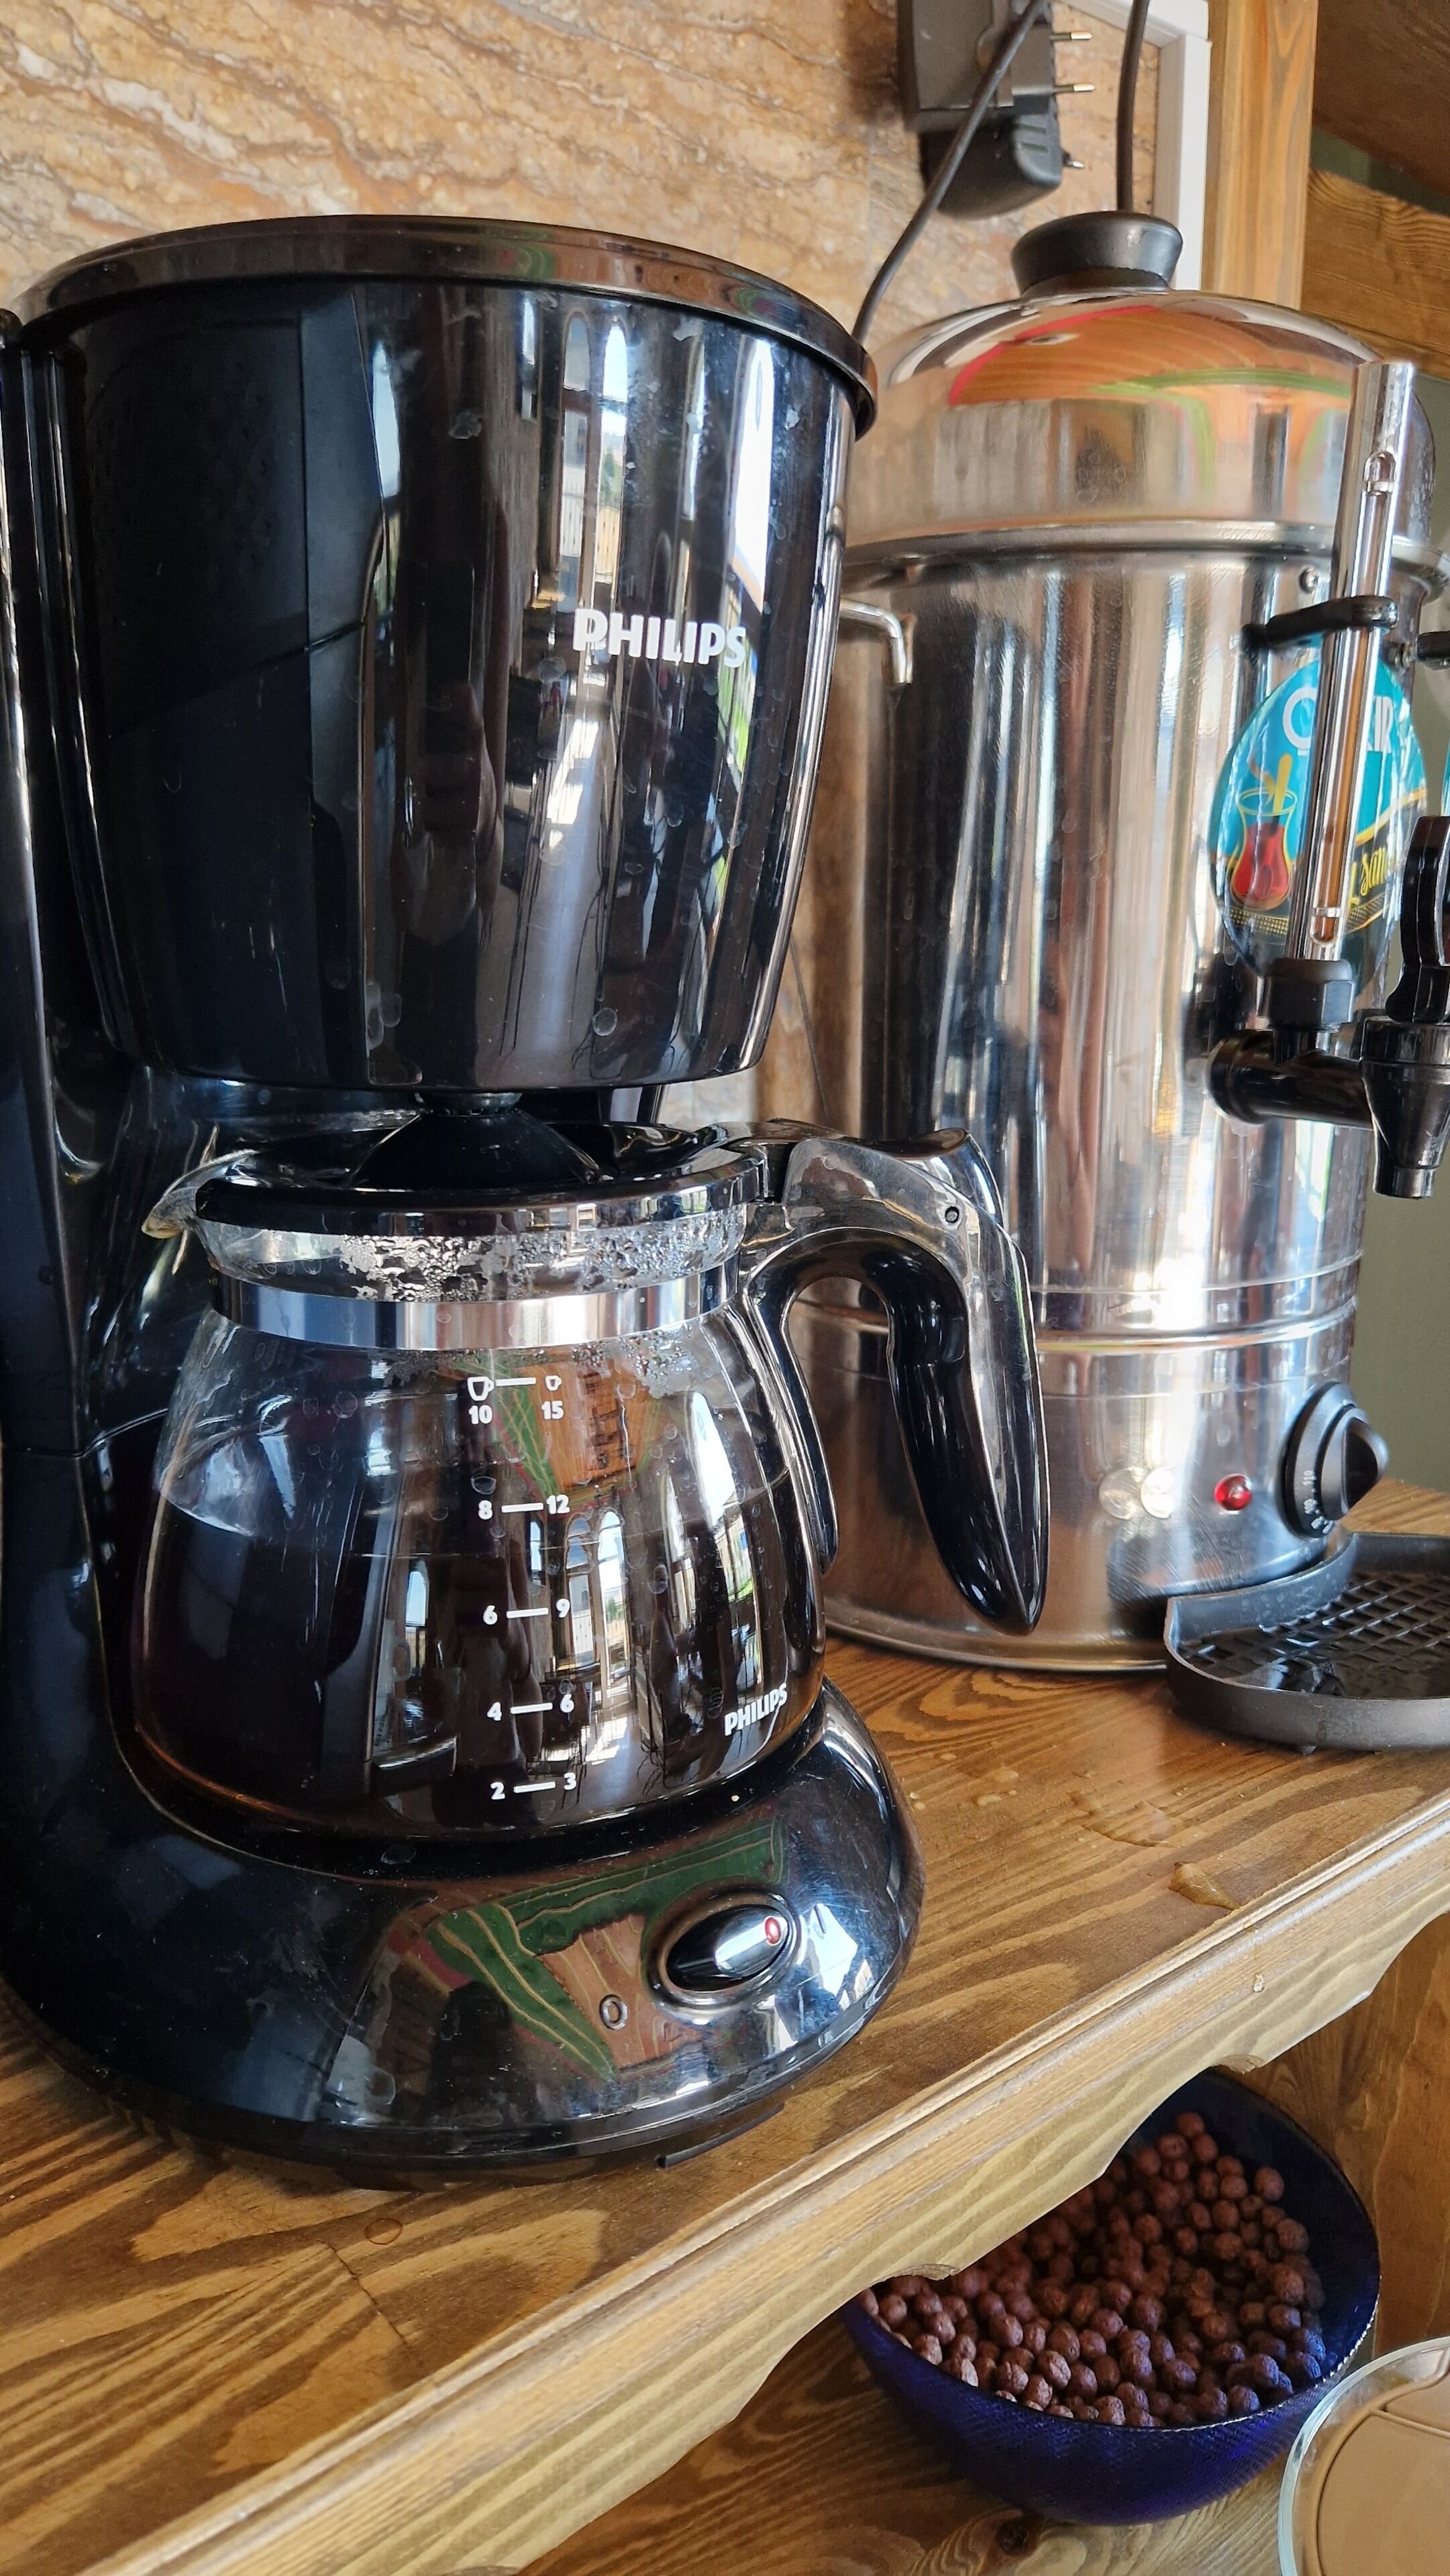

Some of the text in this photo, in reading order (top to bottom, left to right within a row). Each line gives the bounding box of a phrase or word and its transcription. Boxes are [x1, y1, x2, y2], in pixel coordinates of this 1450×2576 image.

[573, 608, 746, 667] PHILIPS
[469, 1405, 493, 1424] 10
[541, 1401, 564, 1419] 15
[478, 1495, 570, 1520] 8 12
[483, 1599, 570, 1625] 6 9
[487, 1694, 574, 1721] 4 6
[725, 1682, 787, 1736] PHILIPS
[490, 1772, 576, 1800] 2 3
